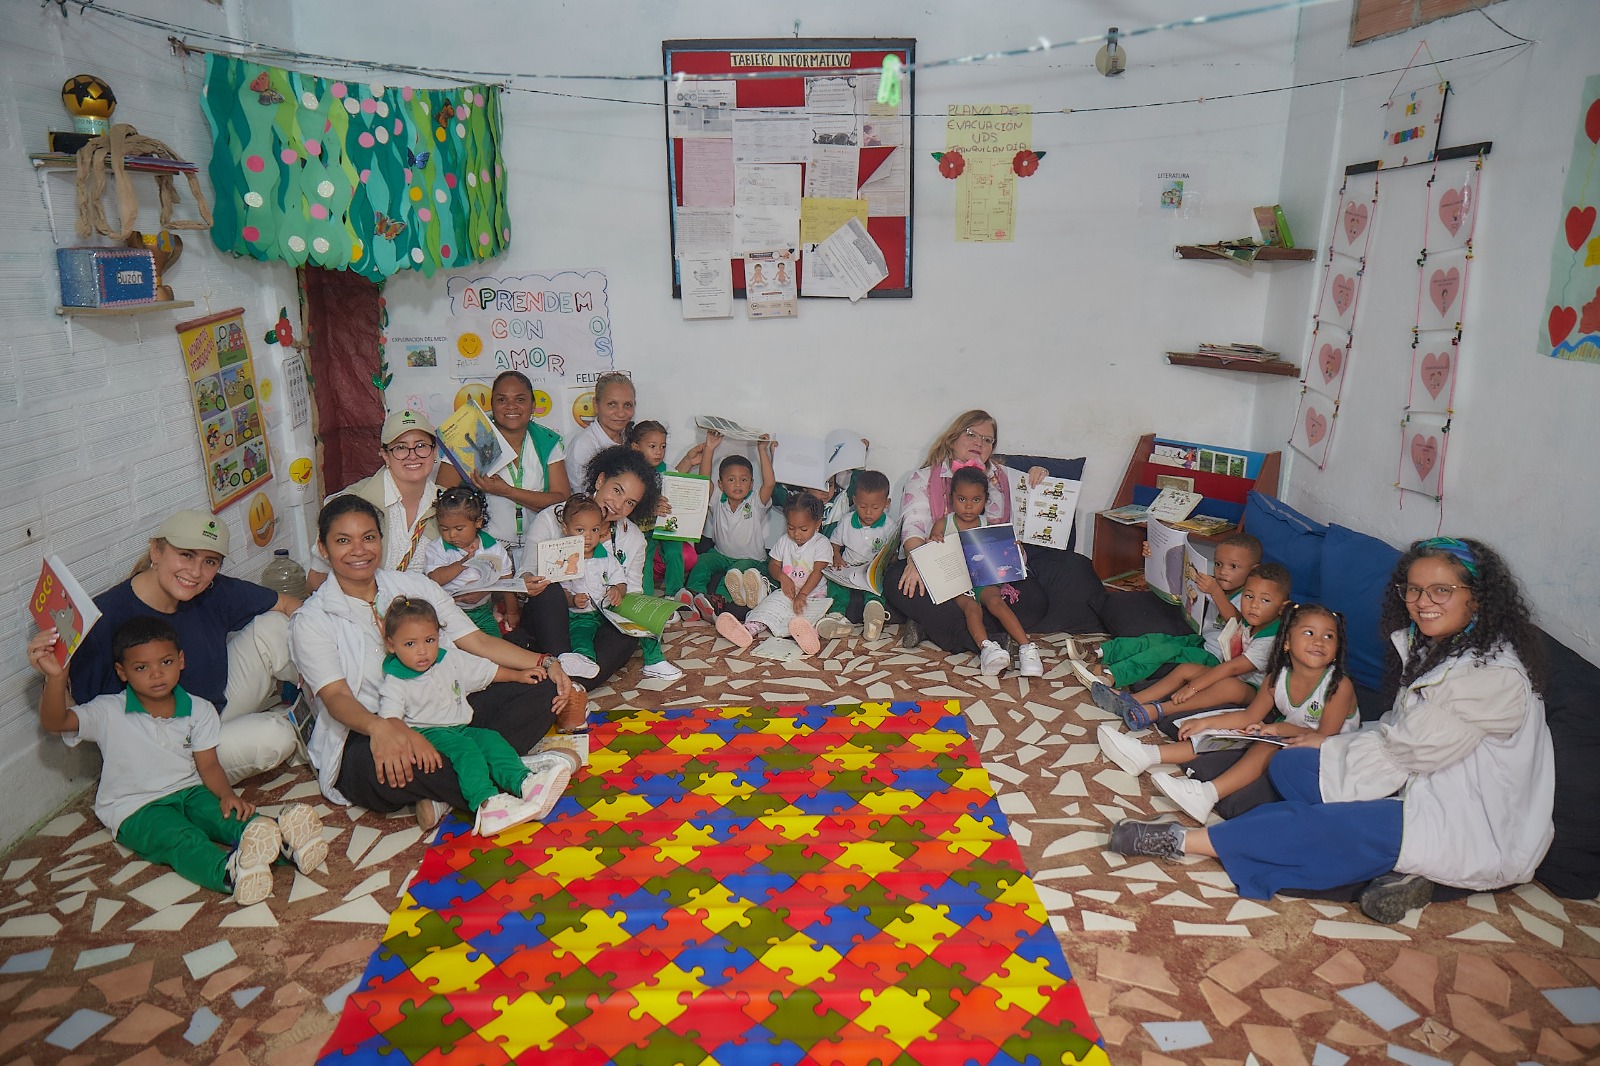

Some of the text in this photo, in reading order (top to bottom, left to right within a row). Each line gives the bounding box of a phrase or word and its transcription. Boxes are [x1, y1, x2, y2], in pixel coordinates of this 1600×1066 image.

[779, 54, 851, 67] INFORMATIVO
[948, 104, 1019, 116] PLANO DE
[972, 132, 998, 144] UDS
[117, 271, 143, 283] Buzón
[491, 318, 543, 340] CON
[495, 347, 565, 377] AMOR
